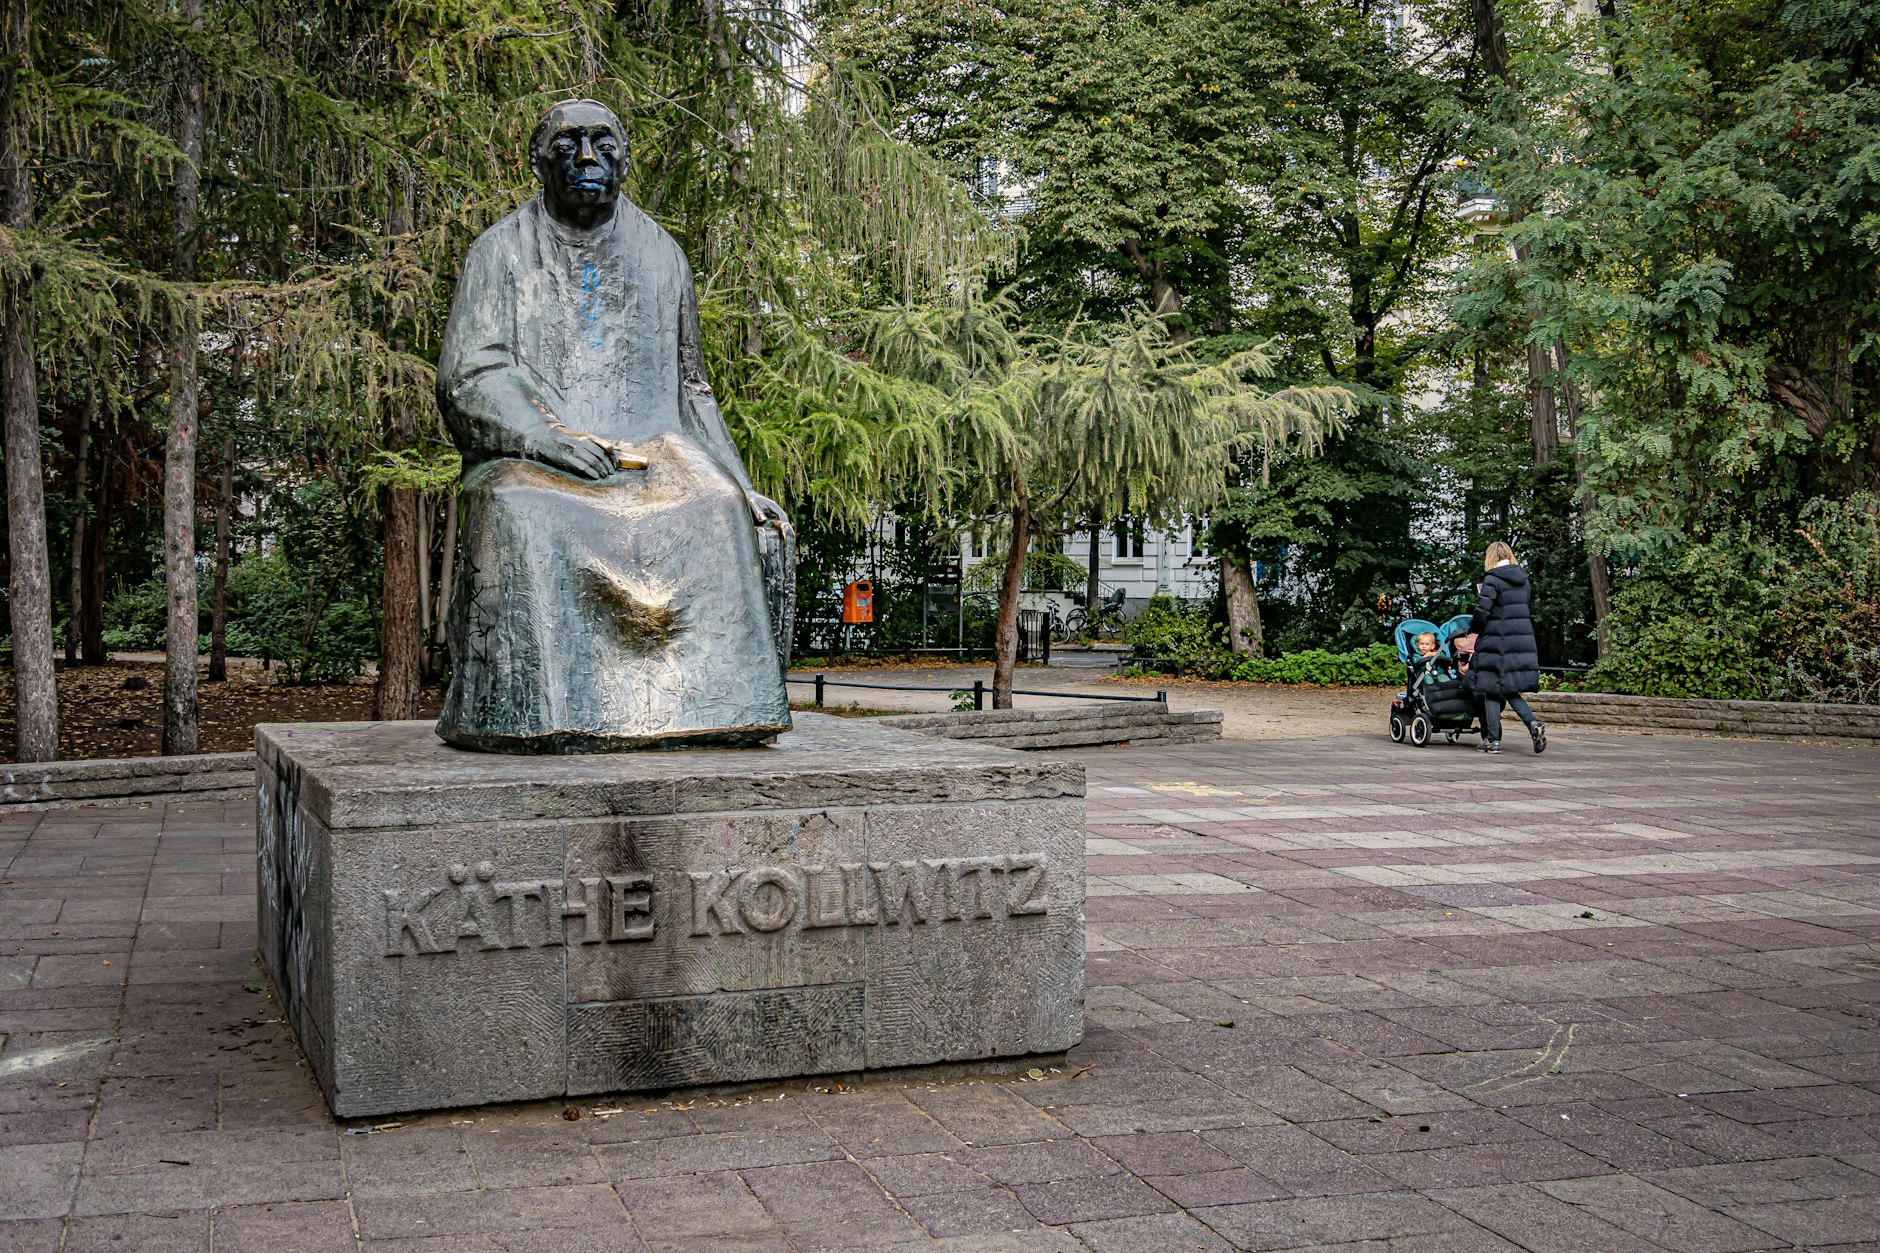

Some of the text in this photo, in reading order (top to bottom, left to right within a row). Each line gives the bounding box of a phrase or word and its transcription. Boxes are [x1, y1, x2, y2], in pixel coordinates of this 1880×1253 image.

[1076, 531, 1112, 540] AVDA
[382, 853, 1048, 957] KÄTHE KOLLWITZ
